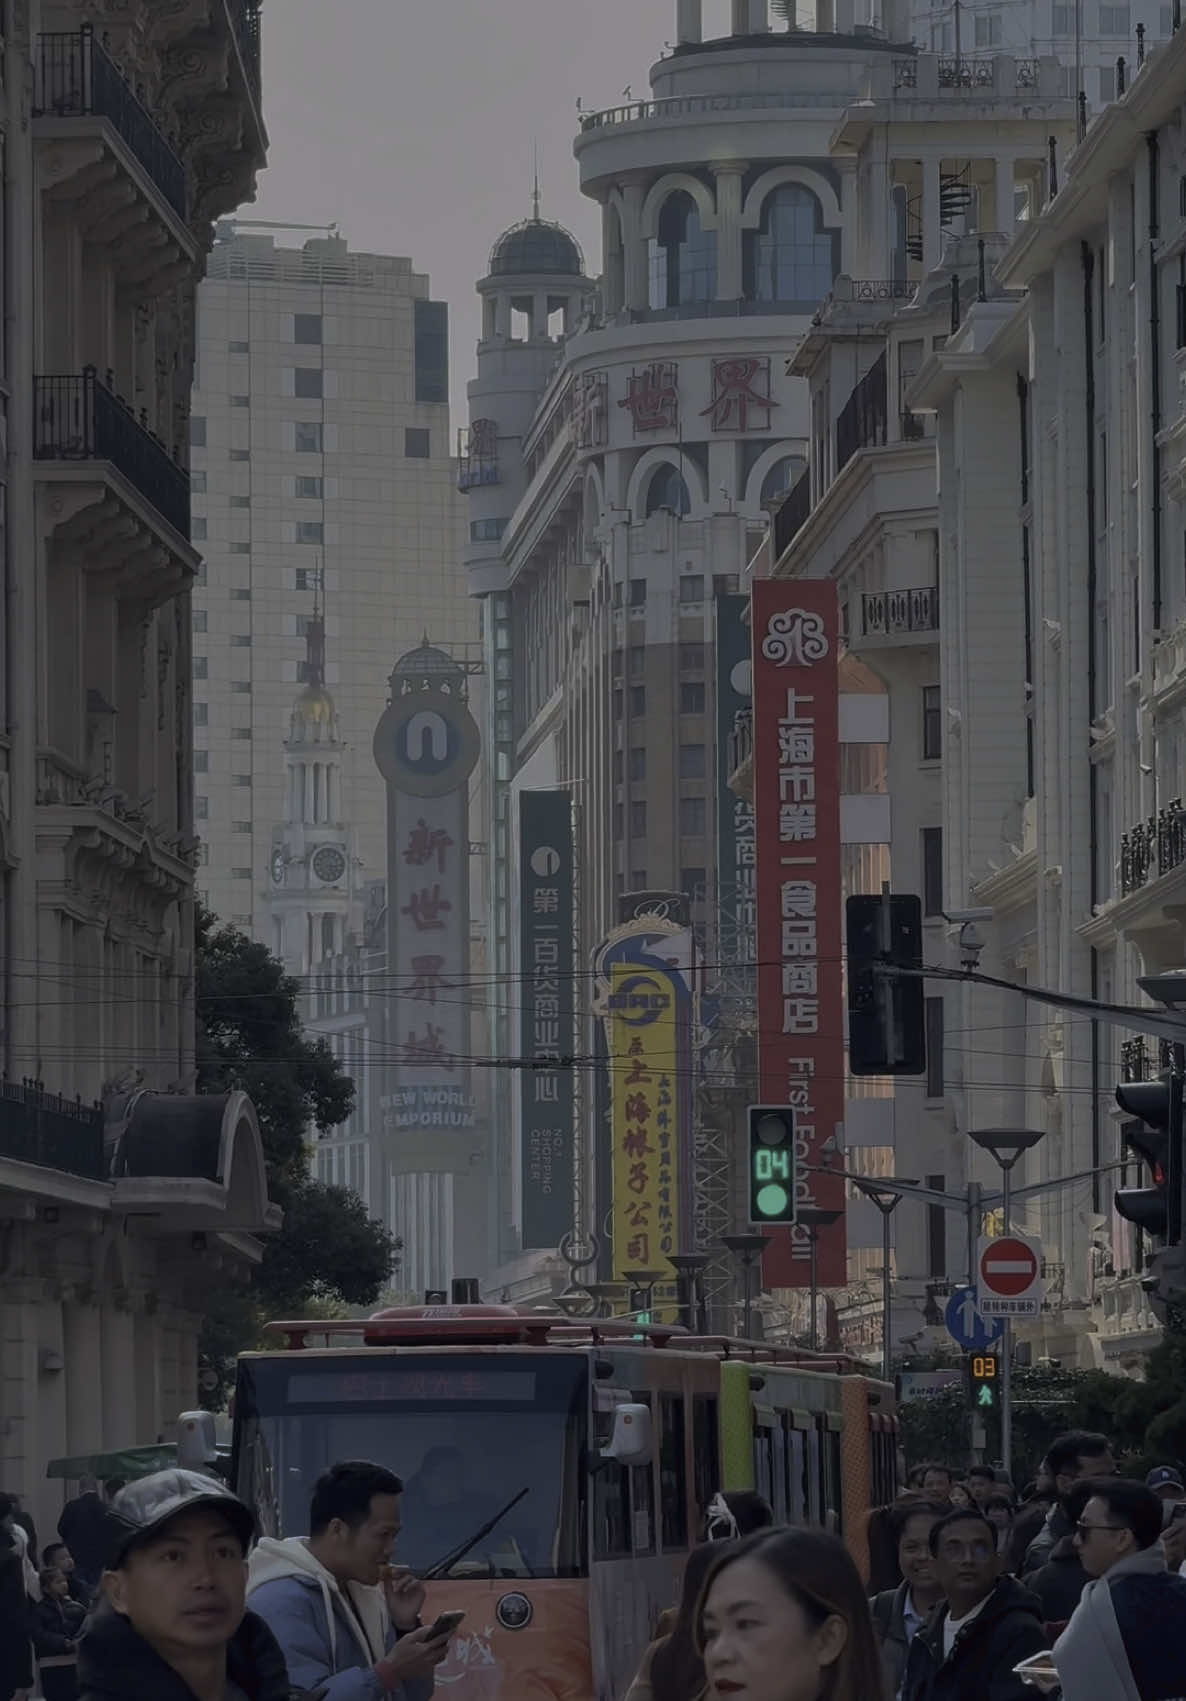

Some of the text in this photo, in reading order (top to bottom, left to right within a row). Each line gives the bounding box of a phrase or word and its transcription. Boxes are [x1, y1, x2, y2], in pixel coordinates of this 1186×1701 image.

[777, 687, 819, 1034] 上海市第一食品商店
[533, 887, 560, 1102] 第一百货商业中心
[788, 1057, 815, 1115] First
[755, 1149, 789, 1180] 04
[973, 1357, 996, 1377] 03
